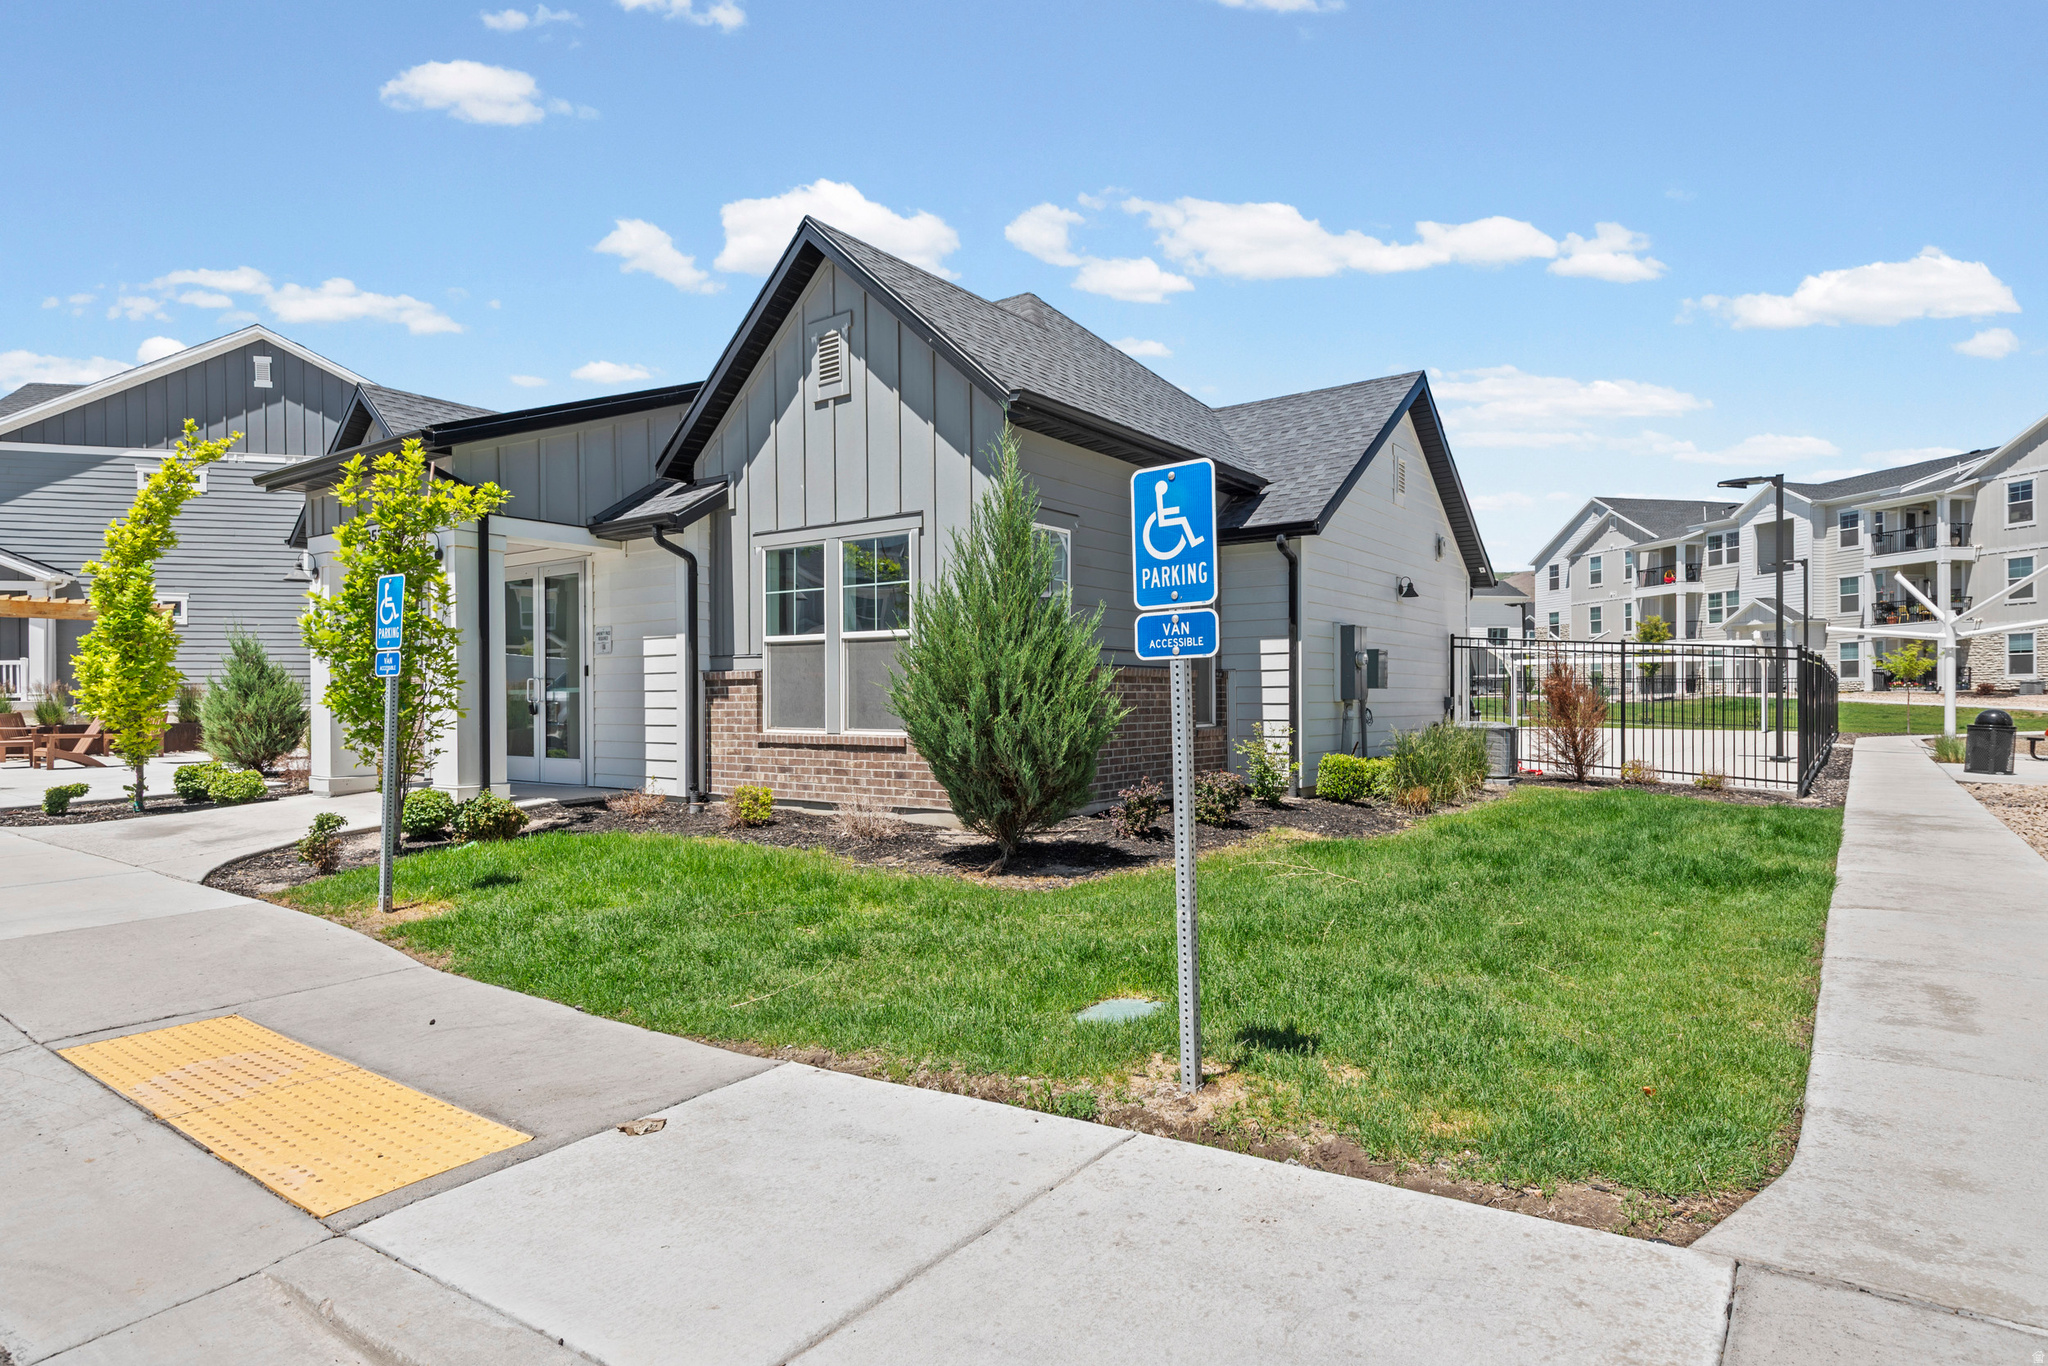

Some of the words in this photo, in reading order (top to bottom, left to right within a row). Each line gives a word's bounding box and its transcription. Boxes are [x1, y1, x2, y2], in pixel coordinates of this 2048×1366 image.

[1142, 562, 1208, 589] PARKING
[379, 627, 399, 639] PARKING
[1162, 622, 1189, 636] VAN
[1149, 637, 1203, 649] ACCESSIBLE
